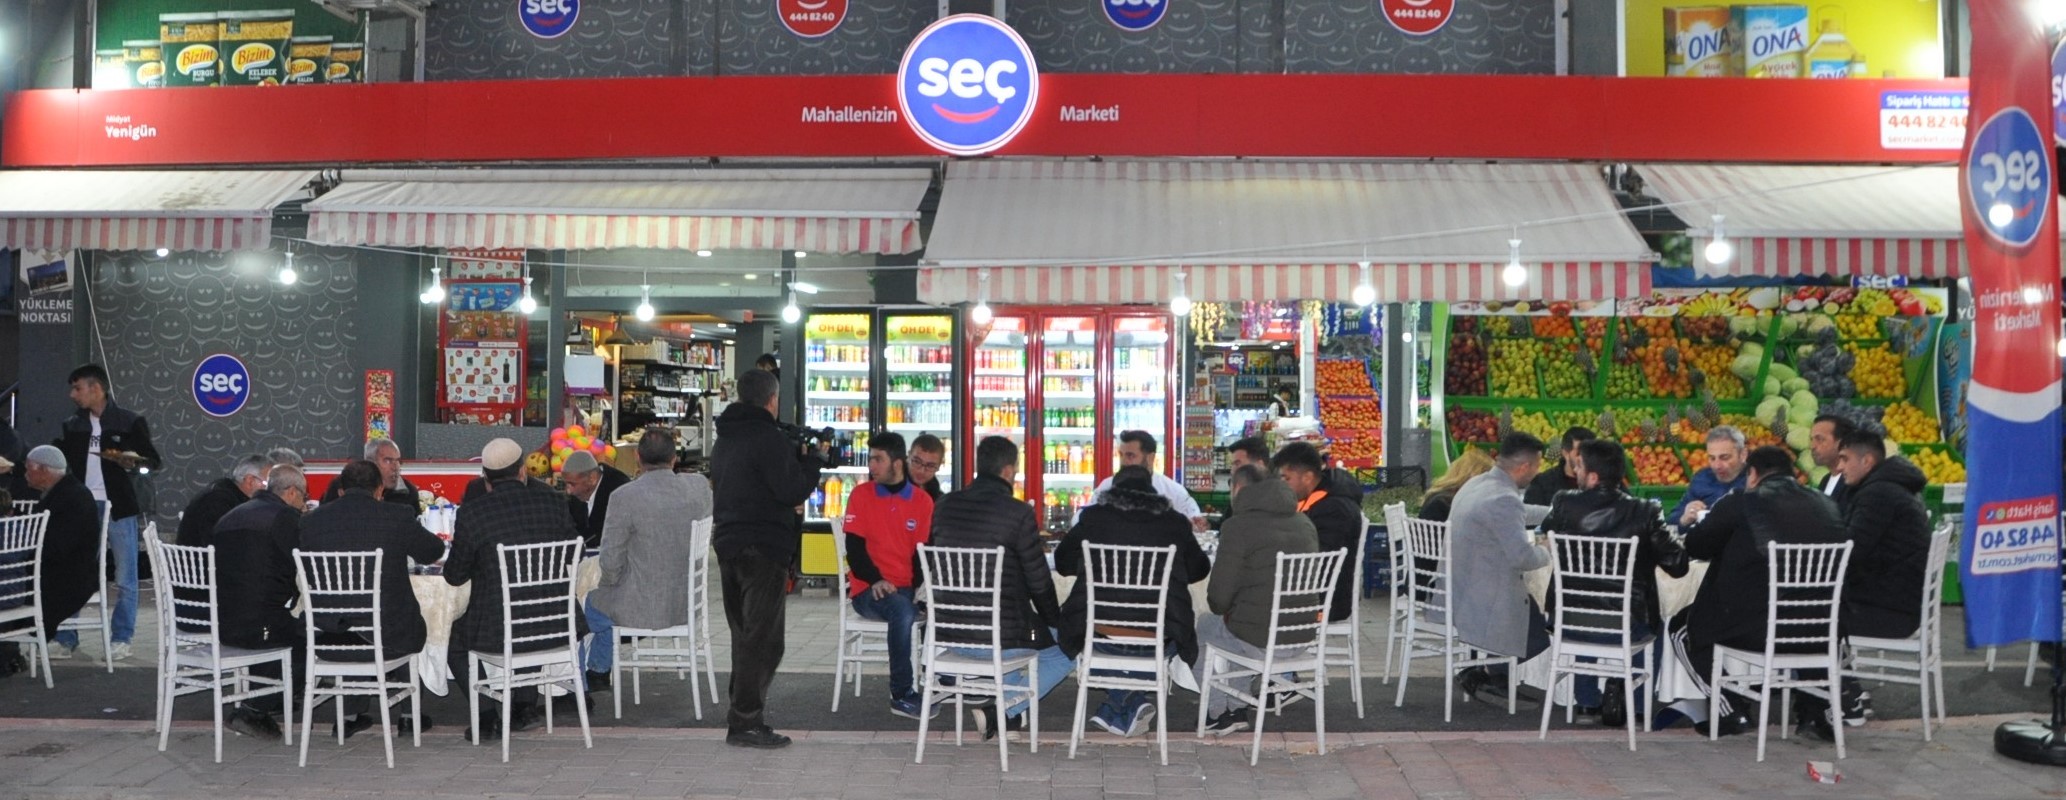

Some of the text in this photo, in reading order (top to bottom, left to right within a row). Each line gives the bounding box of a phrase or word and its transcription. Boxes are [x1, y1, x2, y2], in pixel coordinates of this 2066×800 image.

[526, 0, 572, 15] seç
[1394, 9, 1413, 18] 444
[789, 12, 808, 21] 444
[1688, 26, 1731, 60] ONA
[1752, 26, 1804, 57] ONA
[182, 48, 213, 66] Bizim
[238, 47, 270, 65] Bizim
[248, 68, 277, 76] KELEBEK
[917, 57, 1018, 104] seç
[1886, 94, 1951, 108] Sipariş Hattı
[801, 106, 898, 123] Mahallenizin
[1059, 105, 1119, 122] Marketi
[1888, 115, 1922, 128] 444
[105, 124, 157, 141] Yenigün
[19, 296, 73, 310] YÜKLEME
[20, 312, 71, 323] NOKTASI
[200, 372, 243, 395] seç
